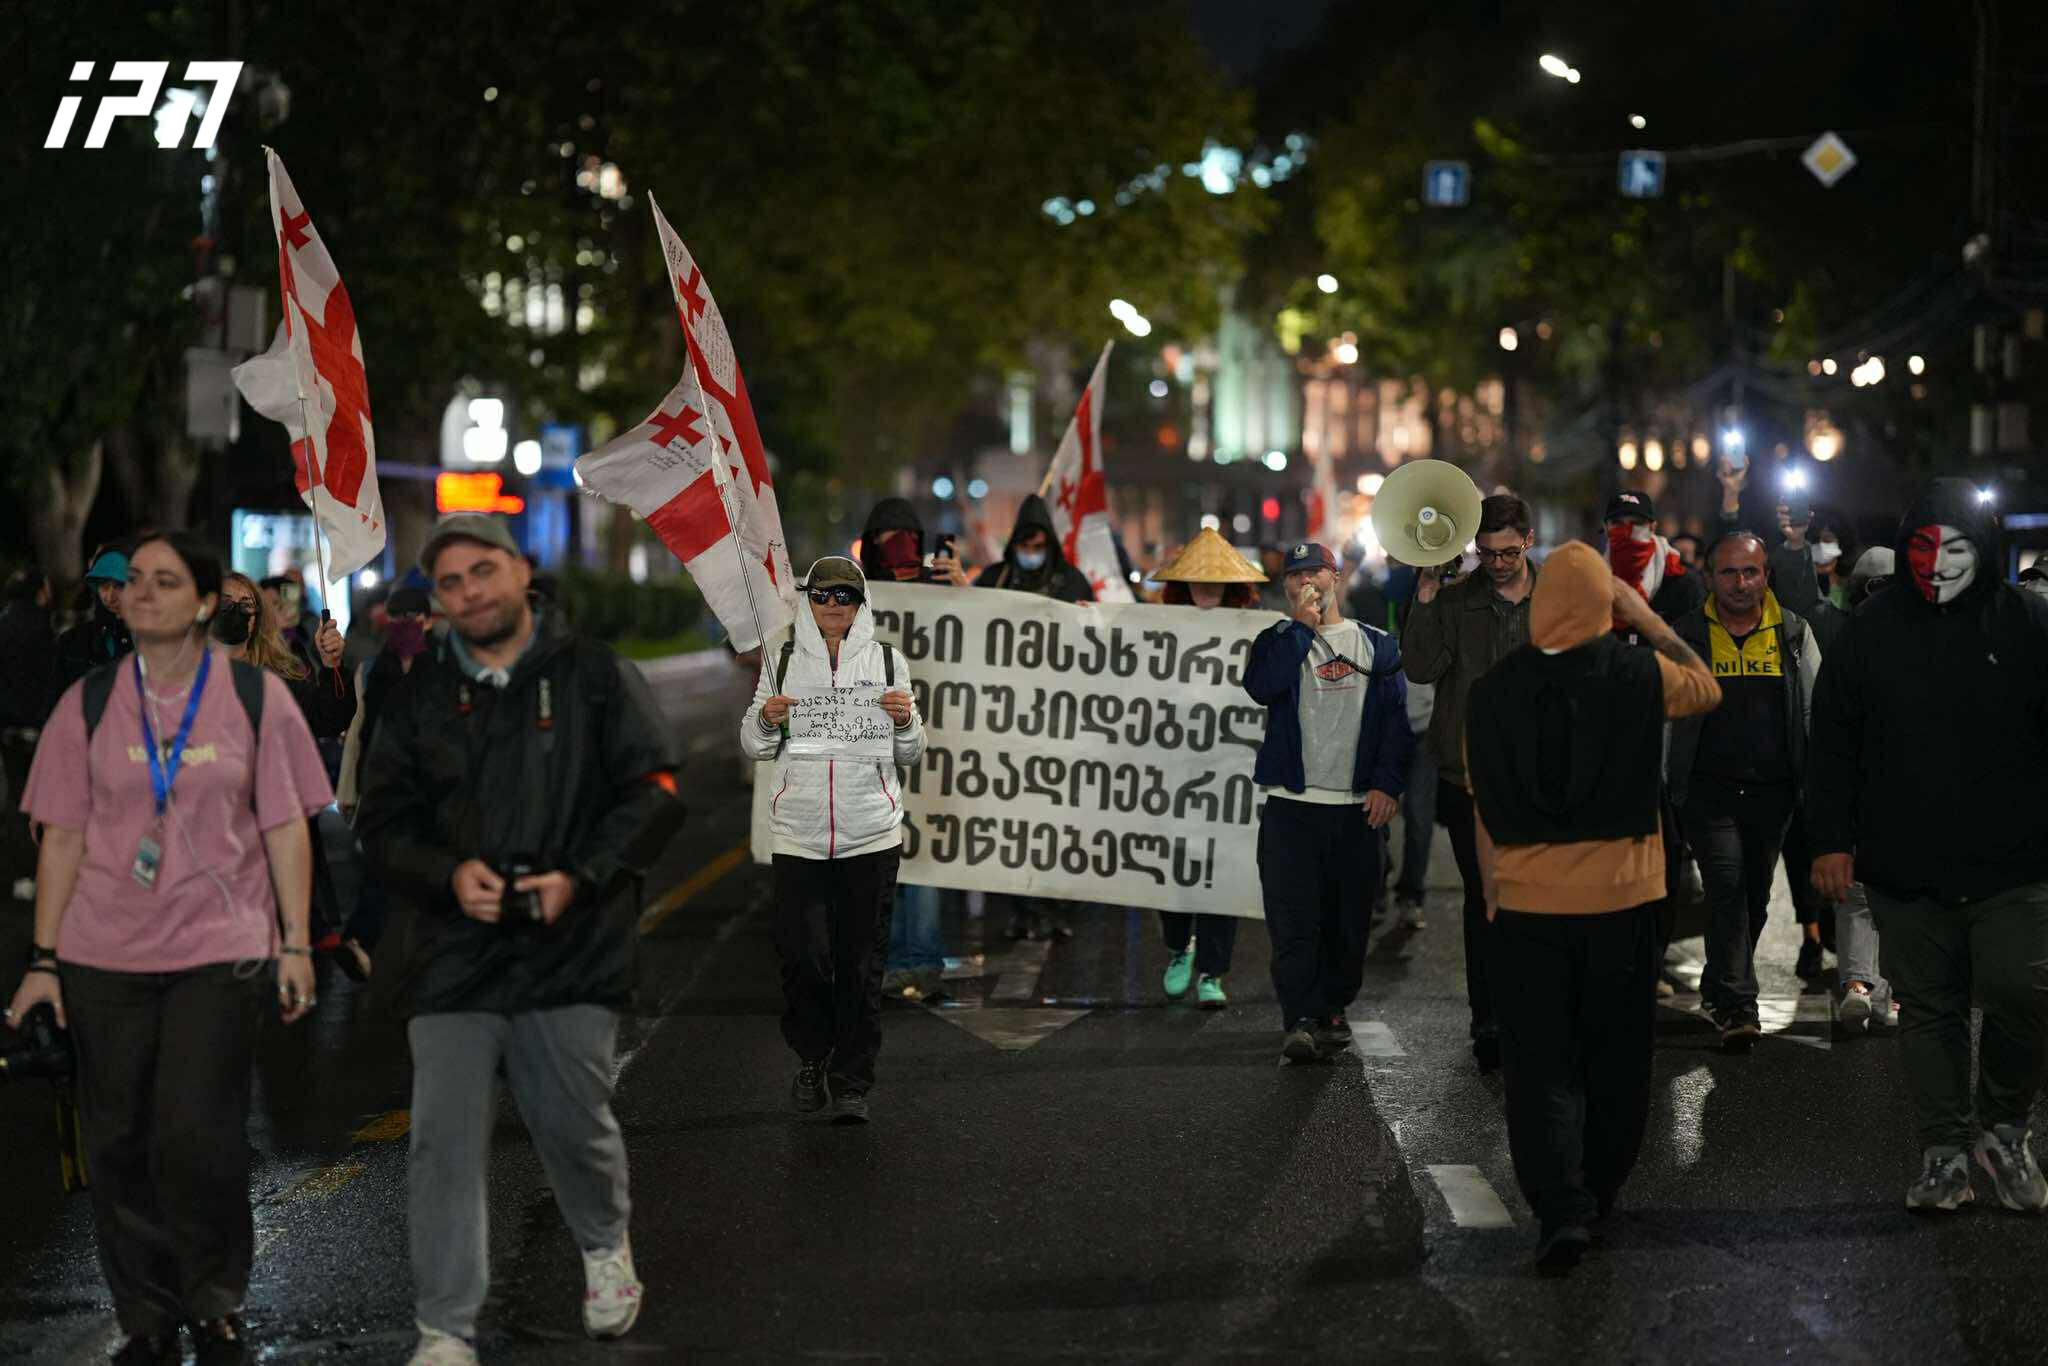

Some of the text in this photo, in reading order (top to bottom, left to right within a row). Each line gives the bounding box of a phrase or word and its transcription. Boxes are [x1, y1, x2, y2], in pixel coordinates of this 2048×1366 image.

[985, 617, 1253, 688] იმსახურე
[1716, 660, 1773, 673] NIKE
[900, 811, 1216, 888] აუწყებელს!
